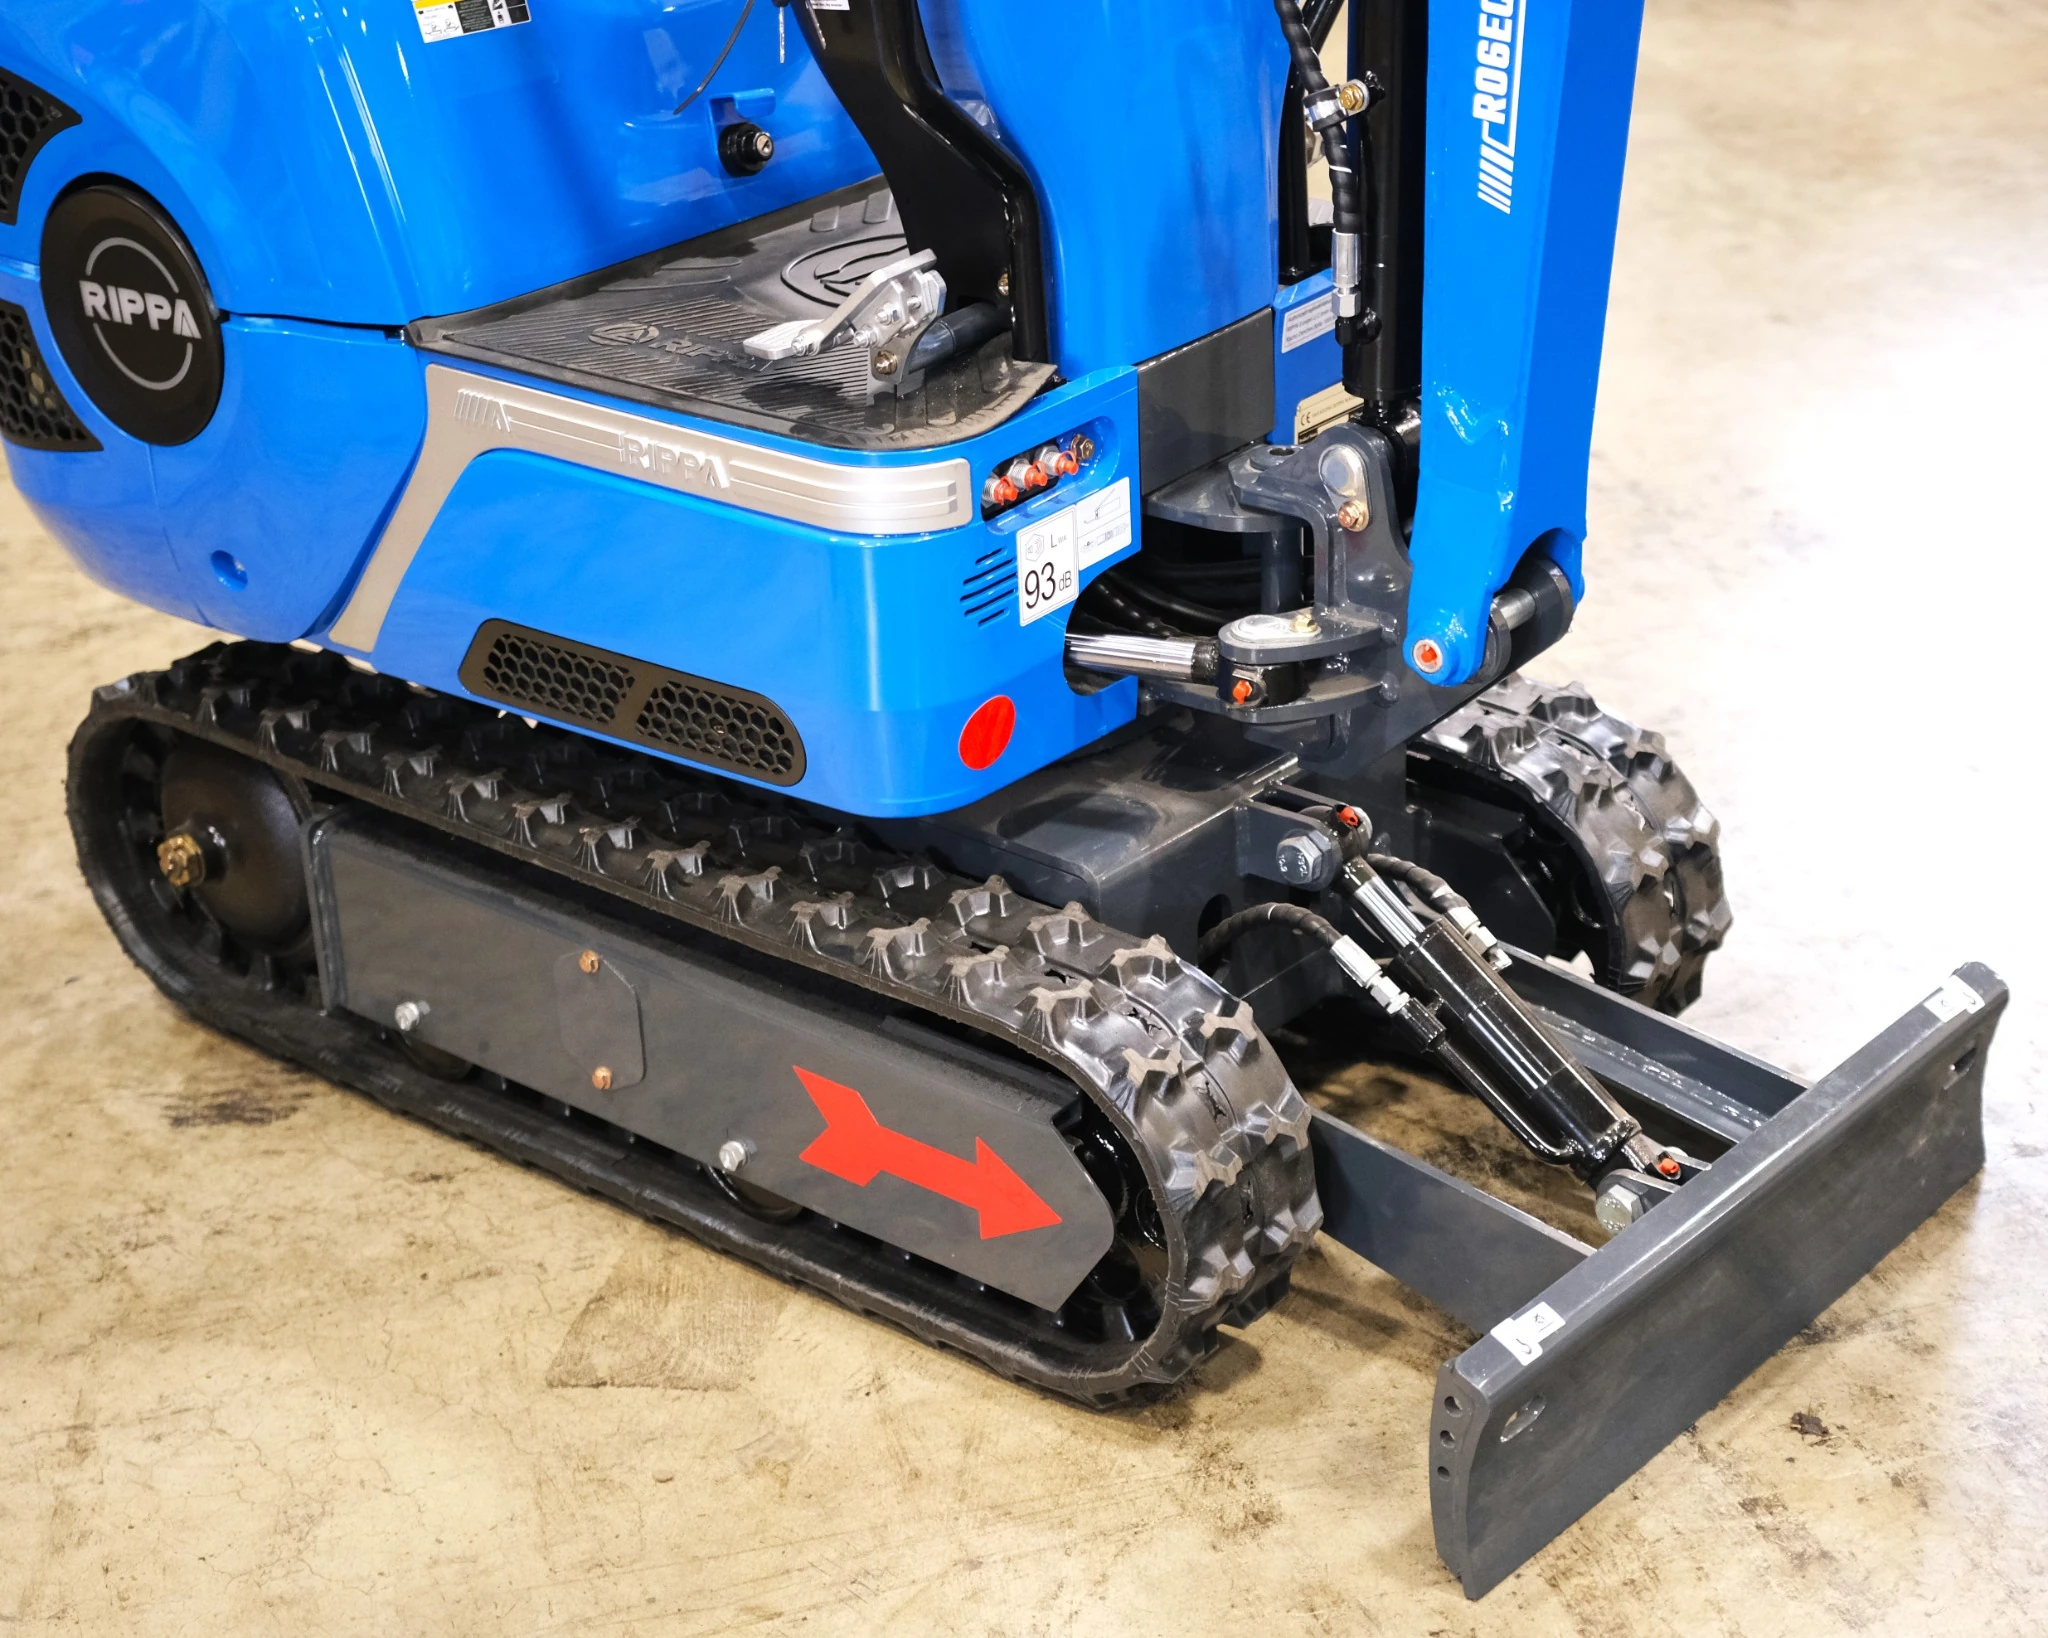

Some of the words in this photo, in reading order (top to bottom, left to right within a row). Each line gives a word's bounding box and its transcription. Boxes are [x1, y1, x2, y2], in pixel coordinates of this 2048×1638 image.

[79, 280, 202, 339] RIPPA
[619, 431, 731, 489] RIPPA
[1024, 561, 1056, 609] 93
[1058, 570, 1072, 591] dB
